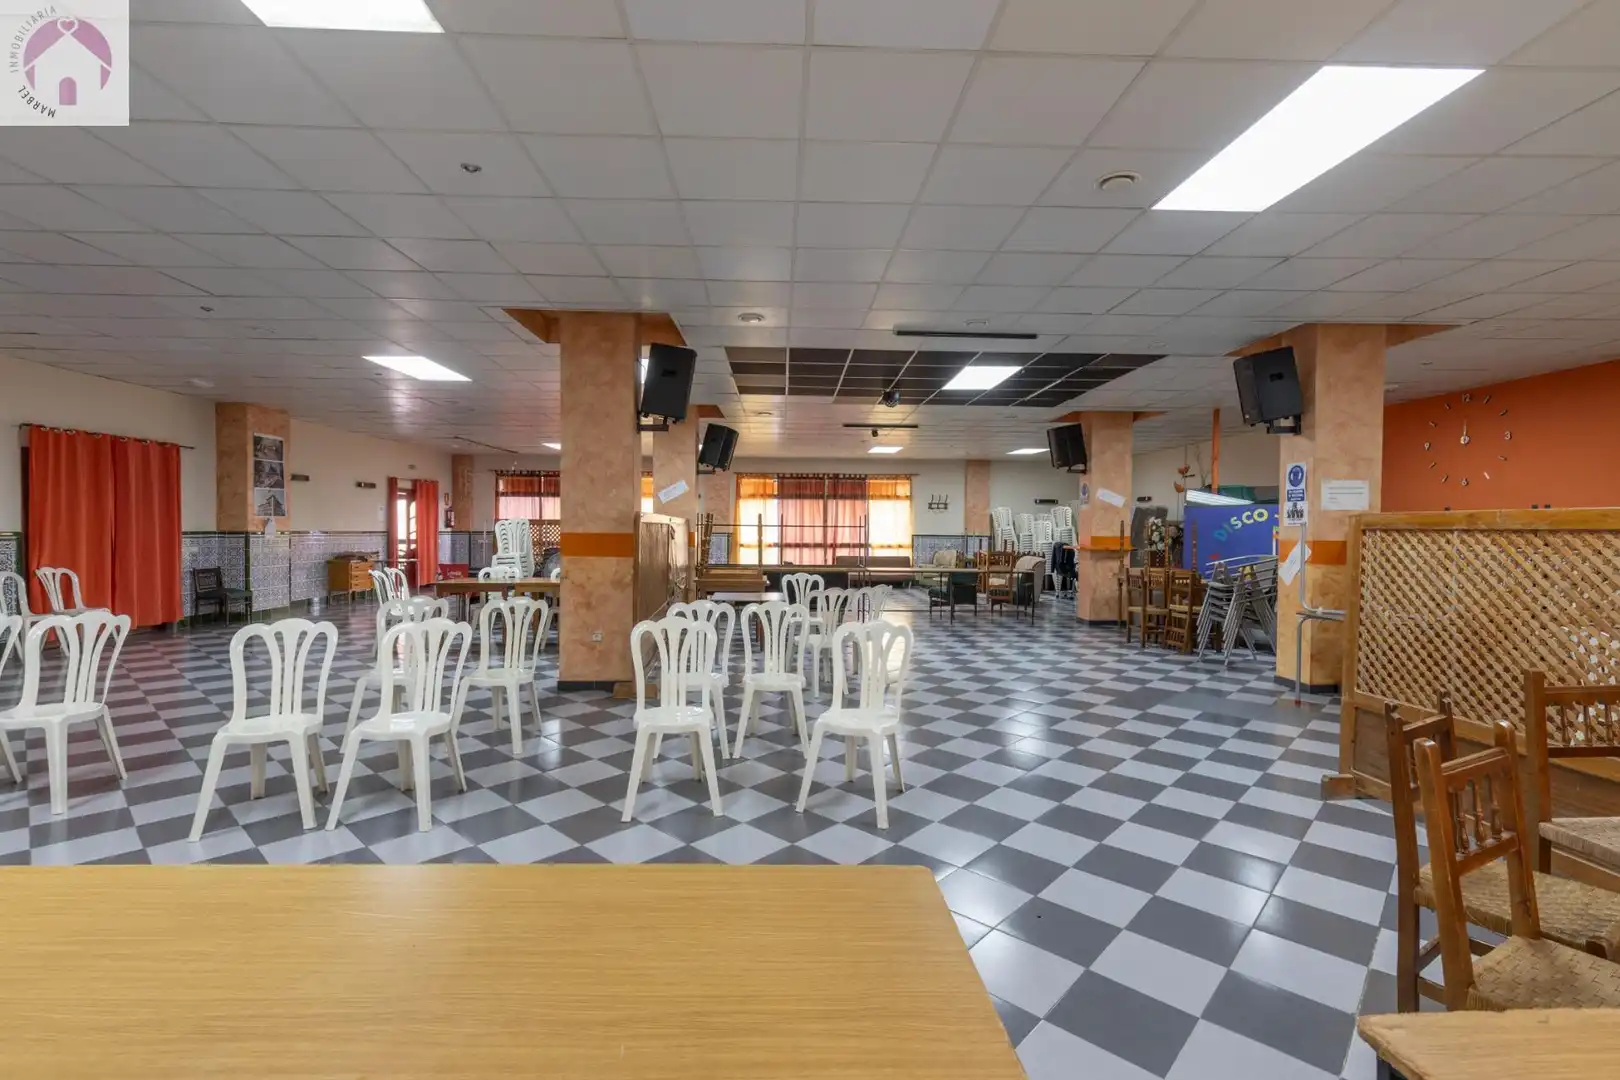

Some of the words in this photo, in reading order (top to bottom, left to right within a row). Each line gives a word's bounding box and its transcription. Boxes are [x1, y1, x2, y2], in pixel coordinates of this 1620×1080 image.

[1462, 394, 1471, 402] 12
[1505, 431, 1511, 440] 3
[1424, 441, 1431, 451] 9
[1213, 508, 1269, 542] DISCO
